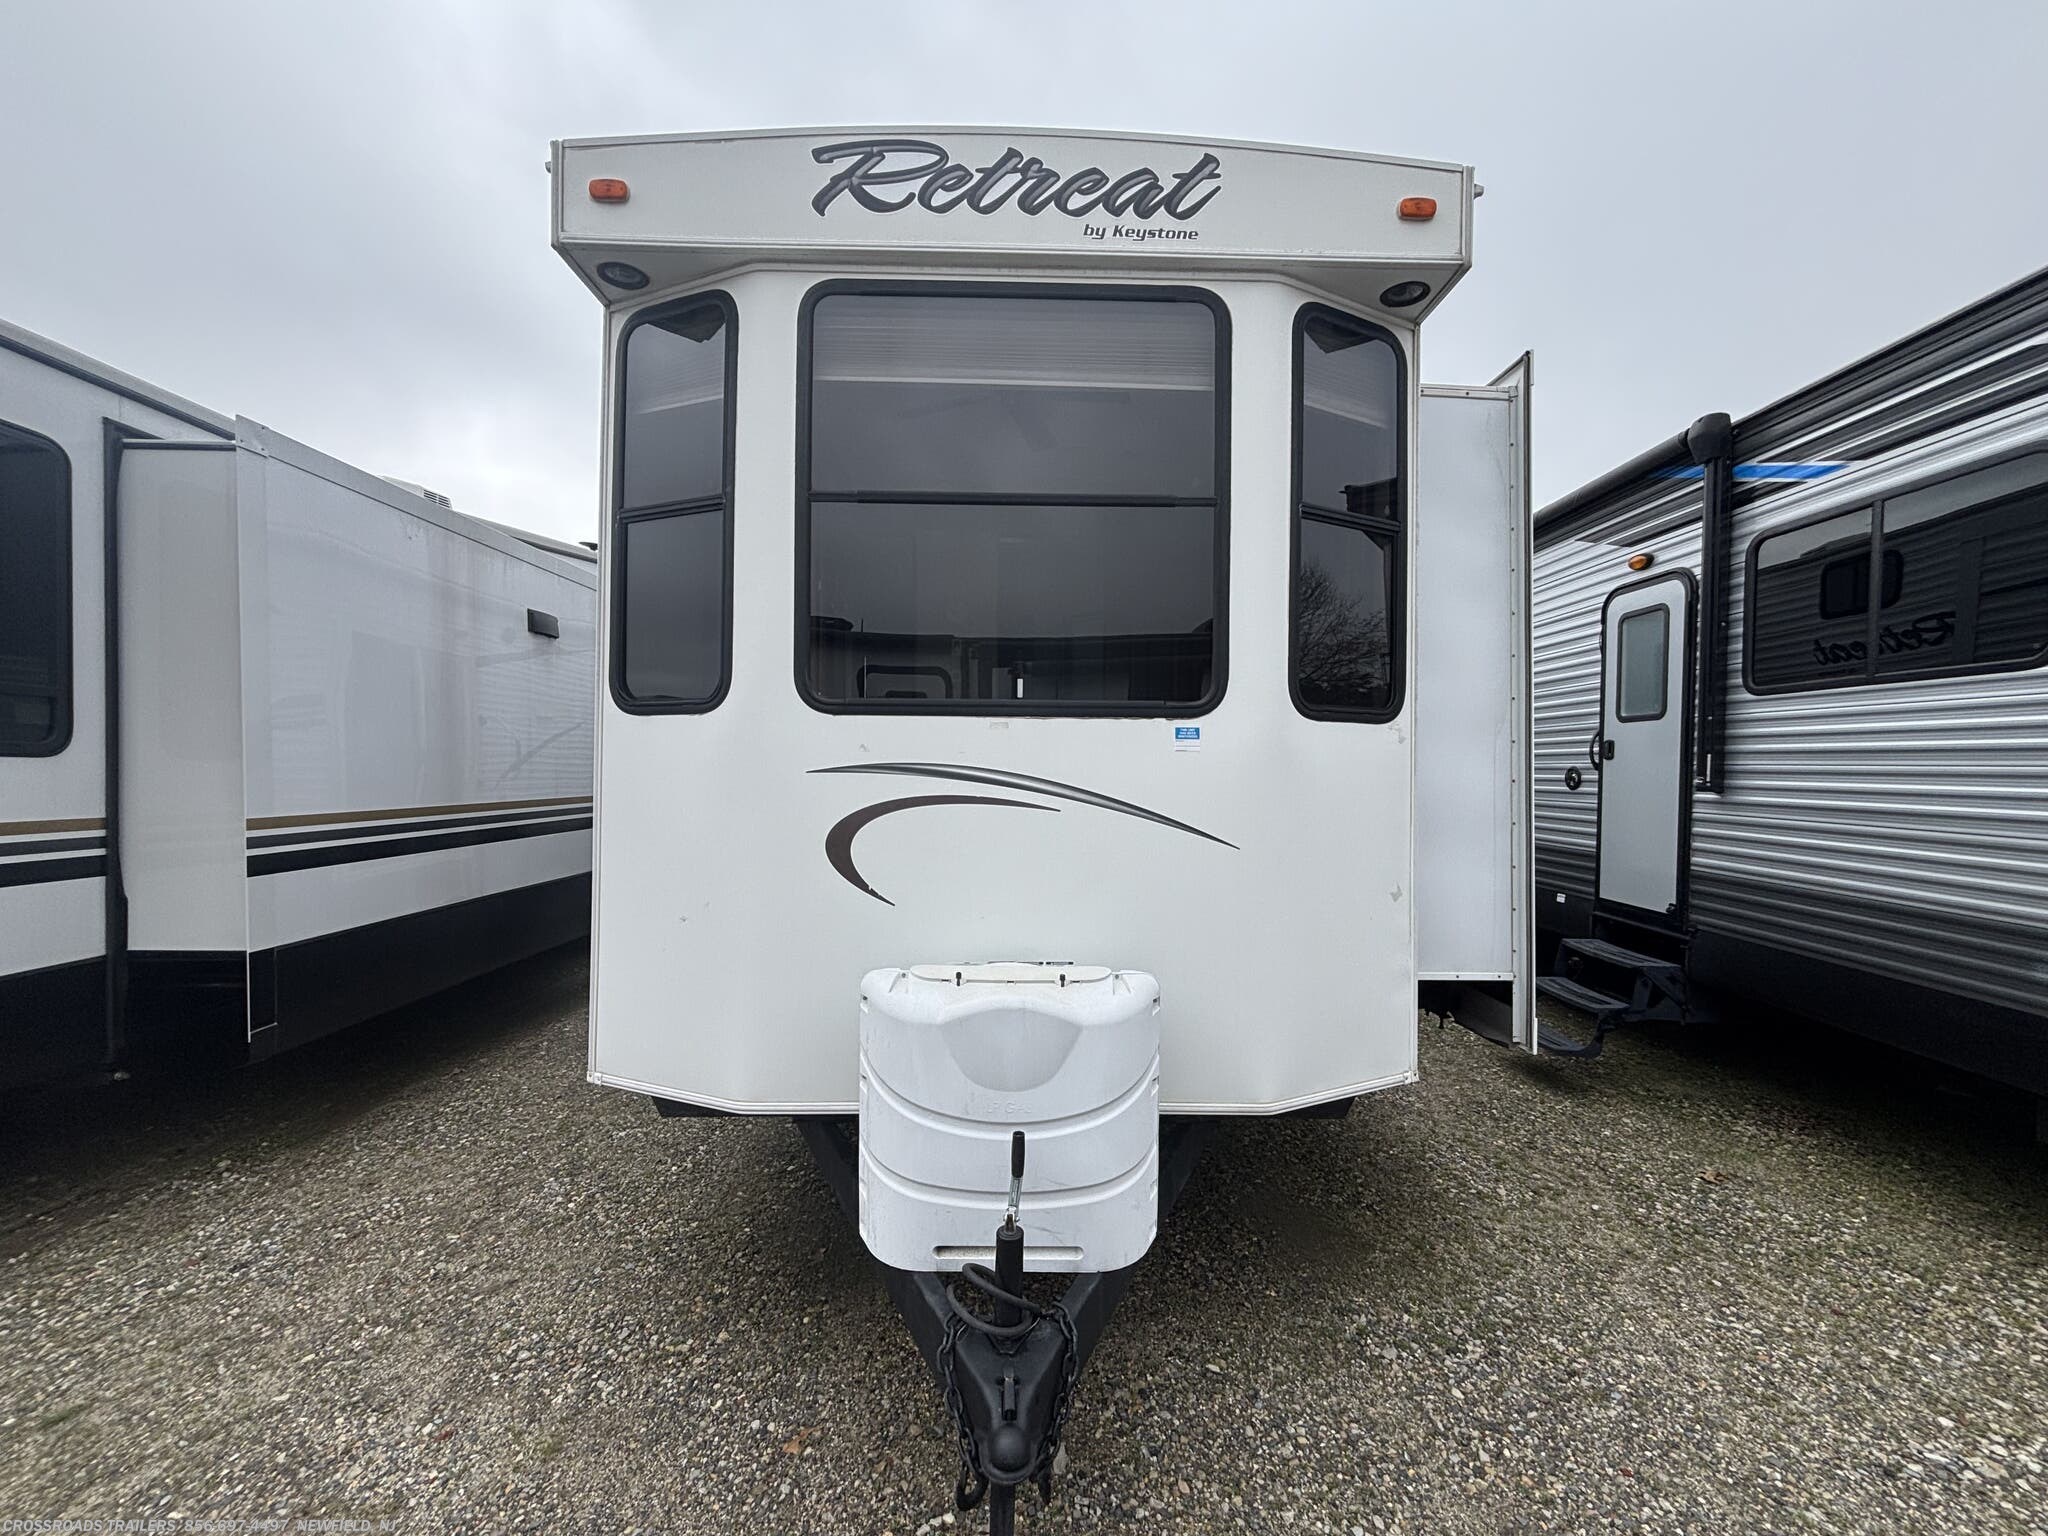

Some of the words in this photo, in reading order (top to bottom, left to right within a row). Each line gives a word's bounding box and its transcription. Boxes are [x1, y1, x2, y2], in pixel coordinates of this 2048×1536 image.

[811, 138, 1222, 221] Retreat
[1083, 223, 1104, 240] by
[1112, 225, 1199, 241] Keystone
